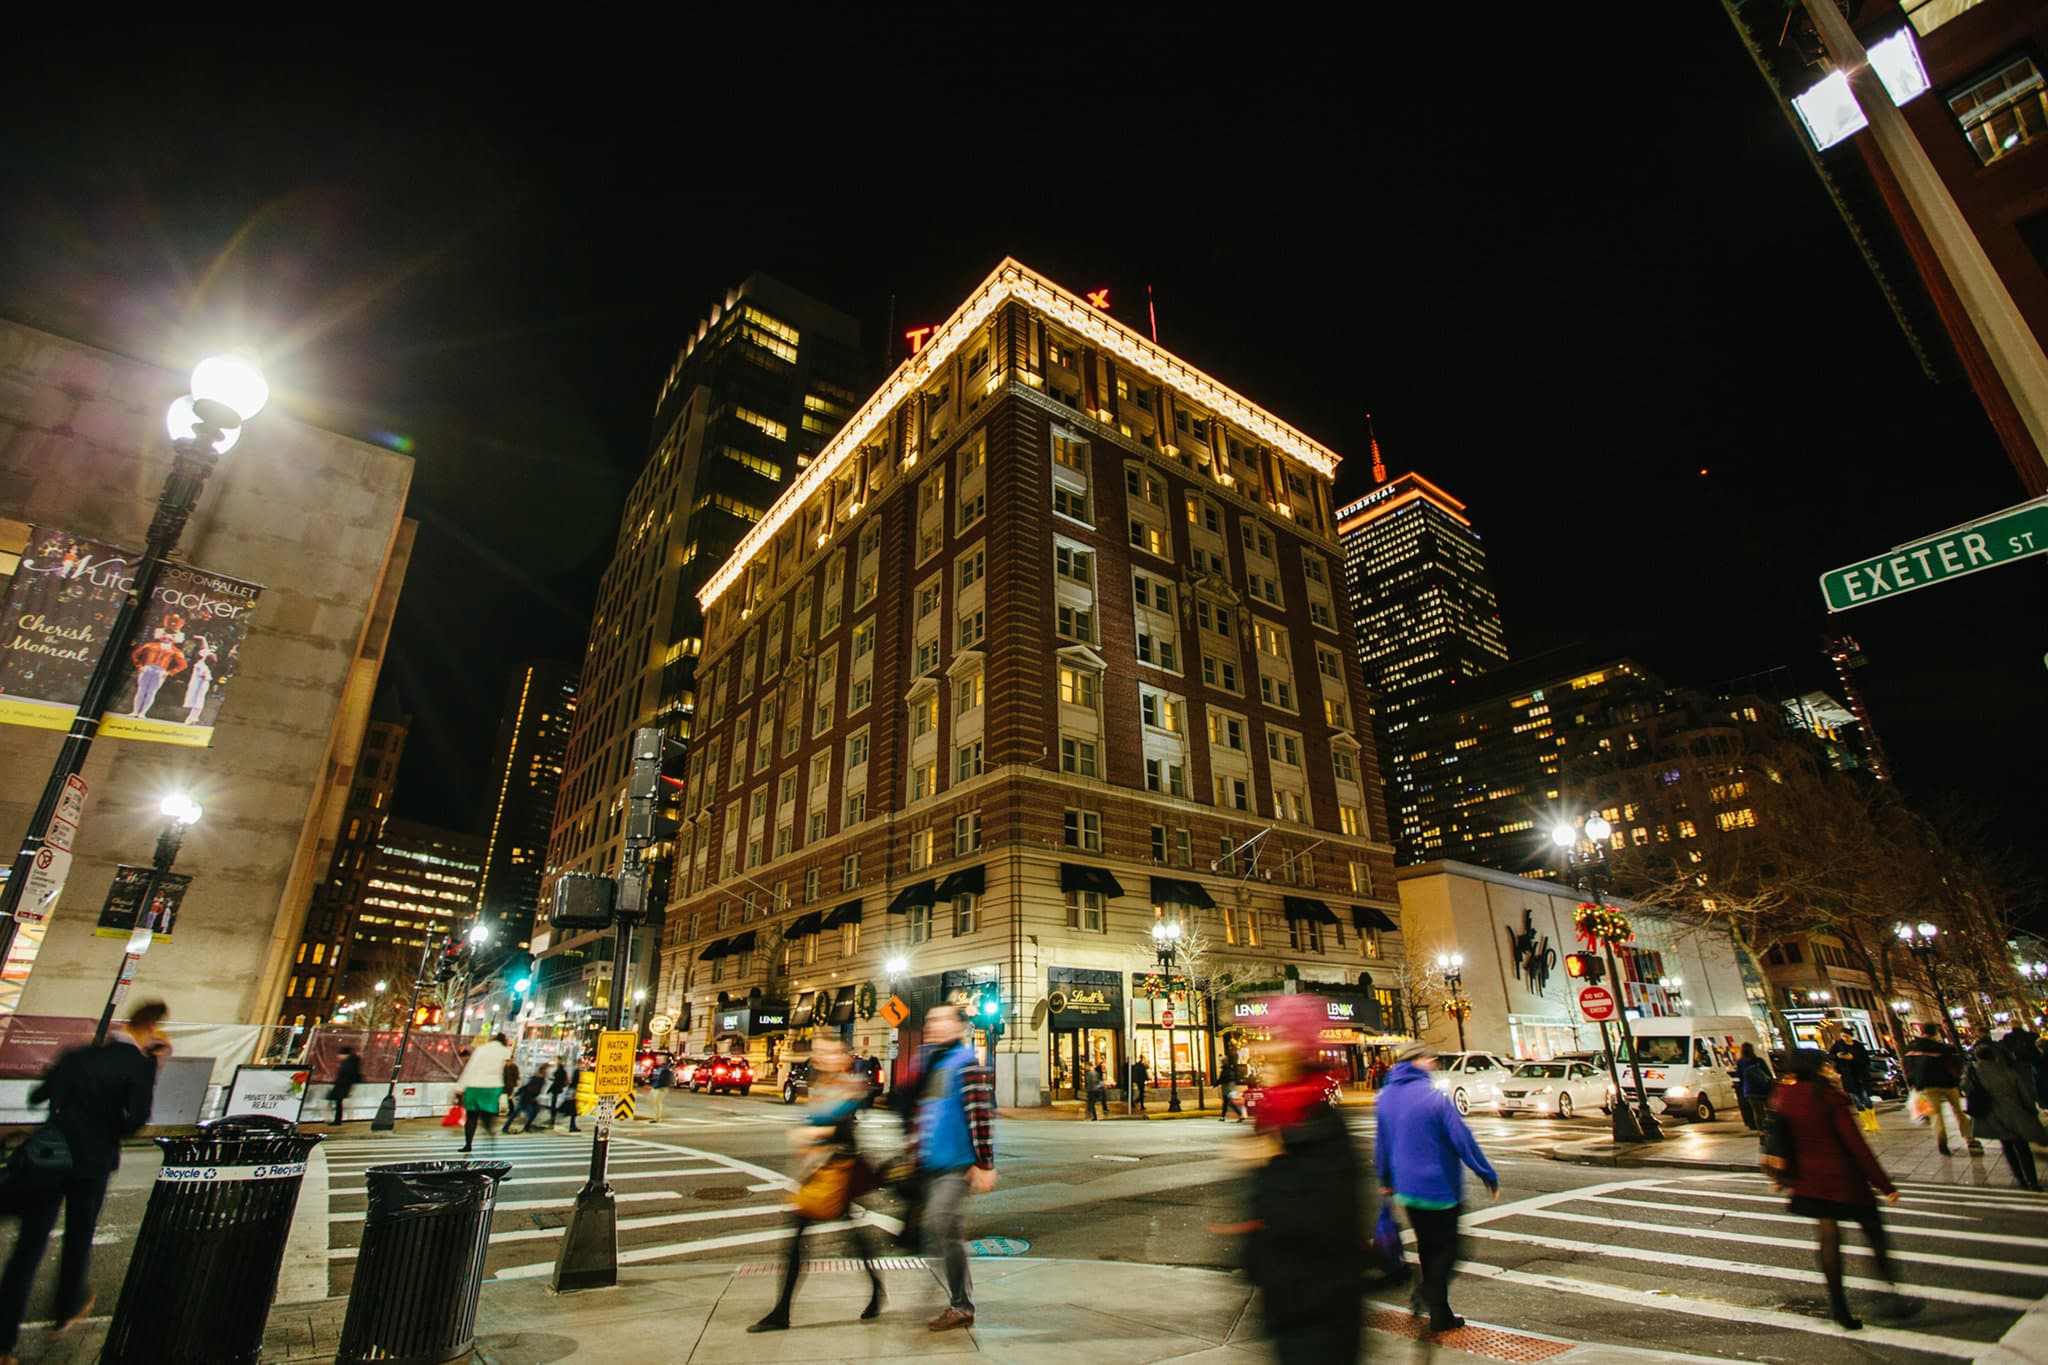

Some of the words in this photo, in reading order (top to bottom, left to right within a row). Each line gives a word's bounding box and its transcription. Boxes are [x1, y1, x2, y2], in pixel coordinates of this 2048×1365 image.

[1336, 486, 1396, 521] RUDENTIAL
[1842, 533, 1993, 602] EXETER
[2009, 532, 2036, 554] ST
[18, 614, 95, 642] Cherish
[2, 635, 88, 662] Moment
[1234, 1003, 1269, 1017] LENOX
[1326, 1003, 1354, 1017] LENOX
[759, 1015, 784, 1024] LENOX
[607, 1041, 629, 1050] WATCH
[609, 1053, 622, 1062] FOR
[602, 1065, 628, 1074] TURNING
[1622, 1069, 1665, 1080] FdEx
[599, 1077, 628, 1087] VEHICLES
[165, 1167, 200, 1179] Recycle
[269, 1164, 302, 1175] Recycle
